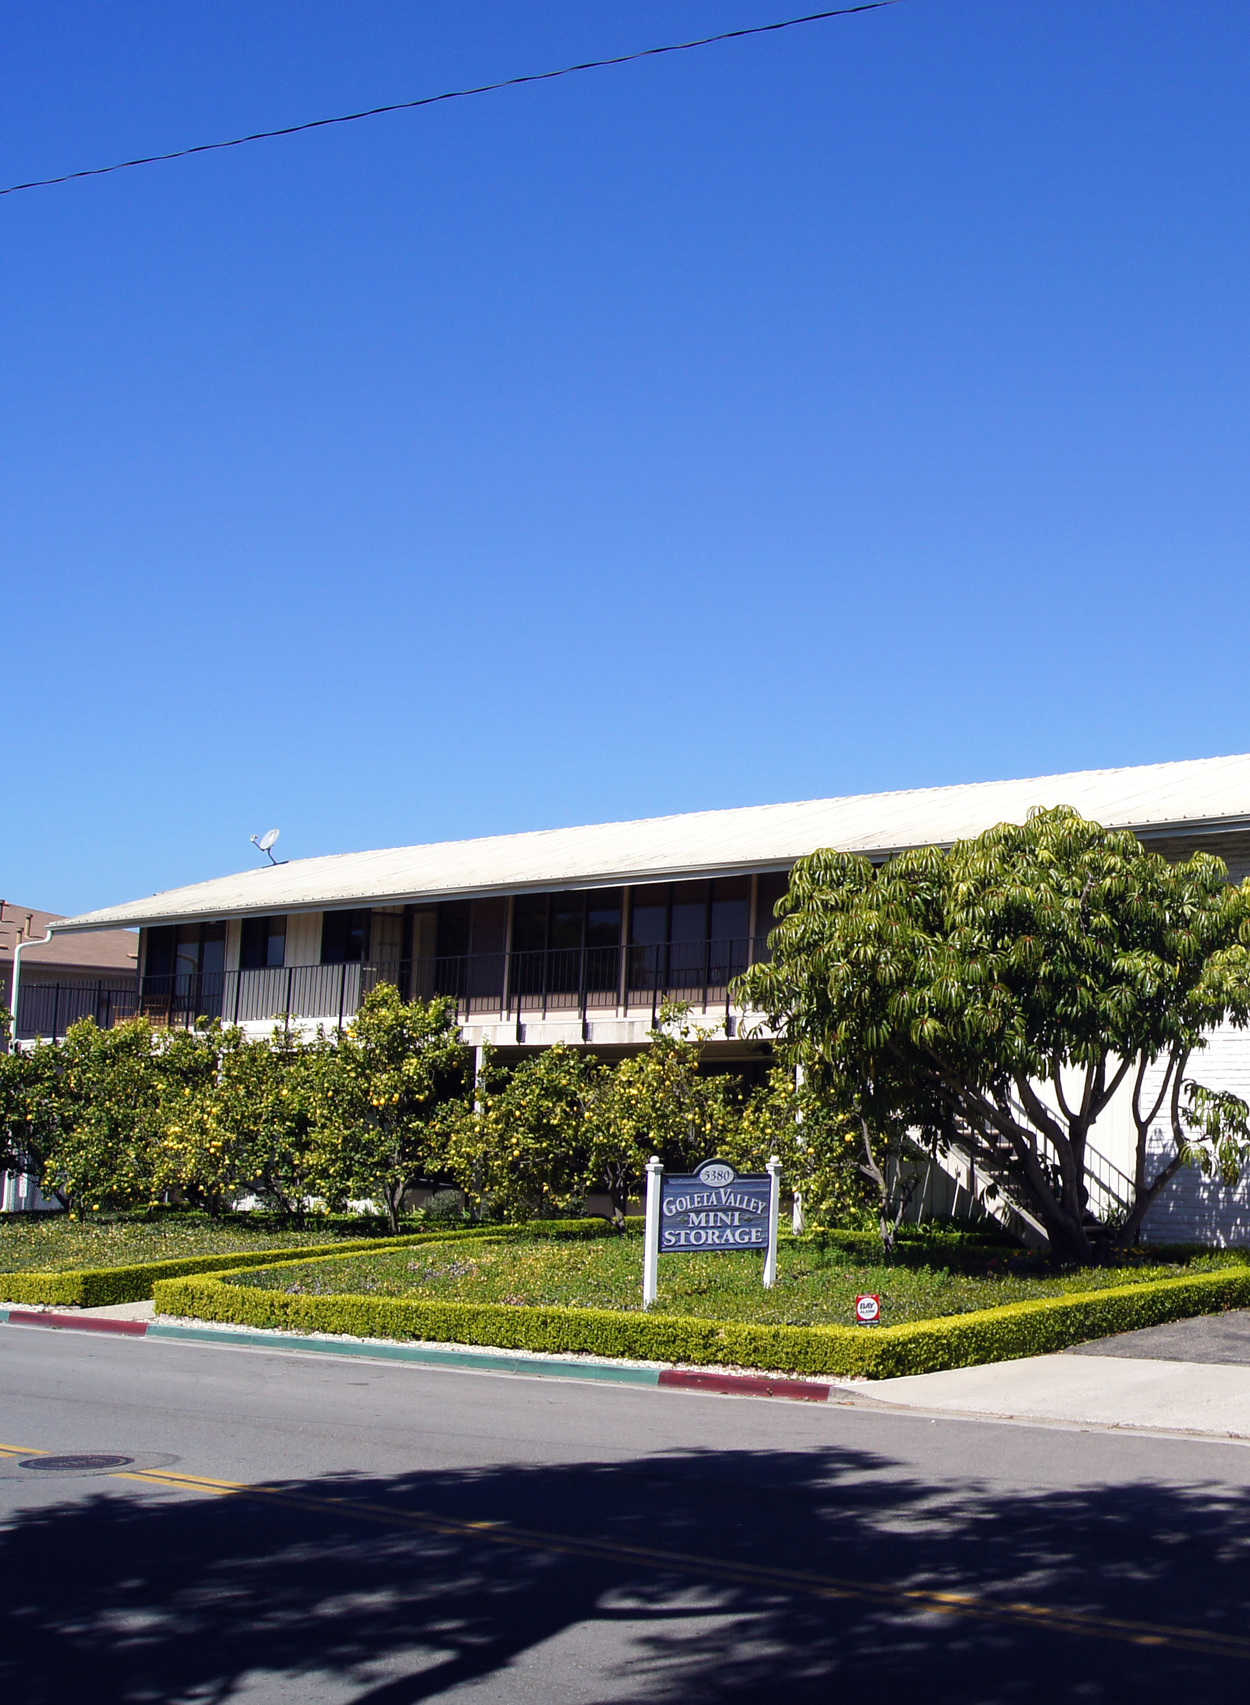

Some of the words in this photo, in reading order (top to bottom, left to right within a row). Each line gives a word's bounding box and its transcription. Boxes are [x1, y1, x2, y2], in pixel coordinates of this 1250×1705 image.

[703, 1170, 730, 1181] 5380
[663, 1191, 718, 1216] GOLETA
[719, 1188, 766, 1215] VALLEY
[688, 1211, 740, 1227] MINI
[663, 1228, 763, 1246] STORAGE
